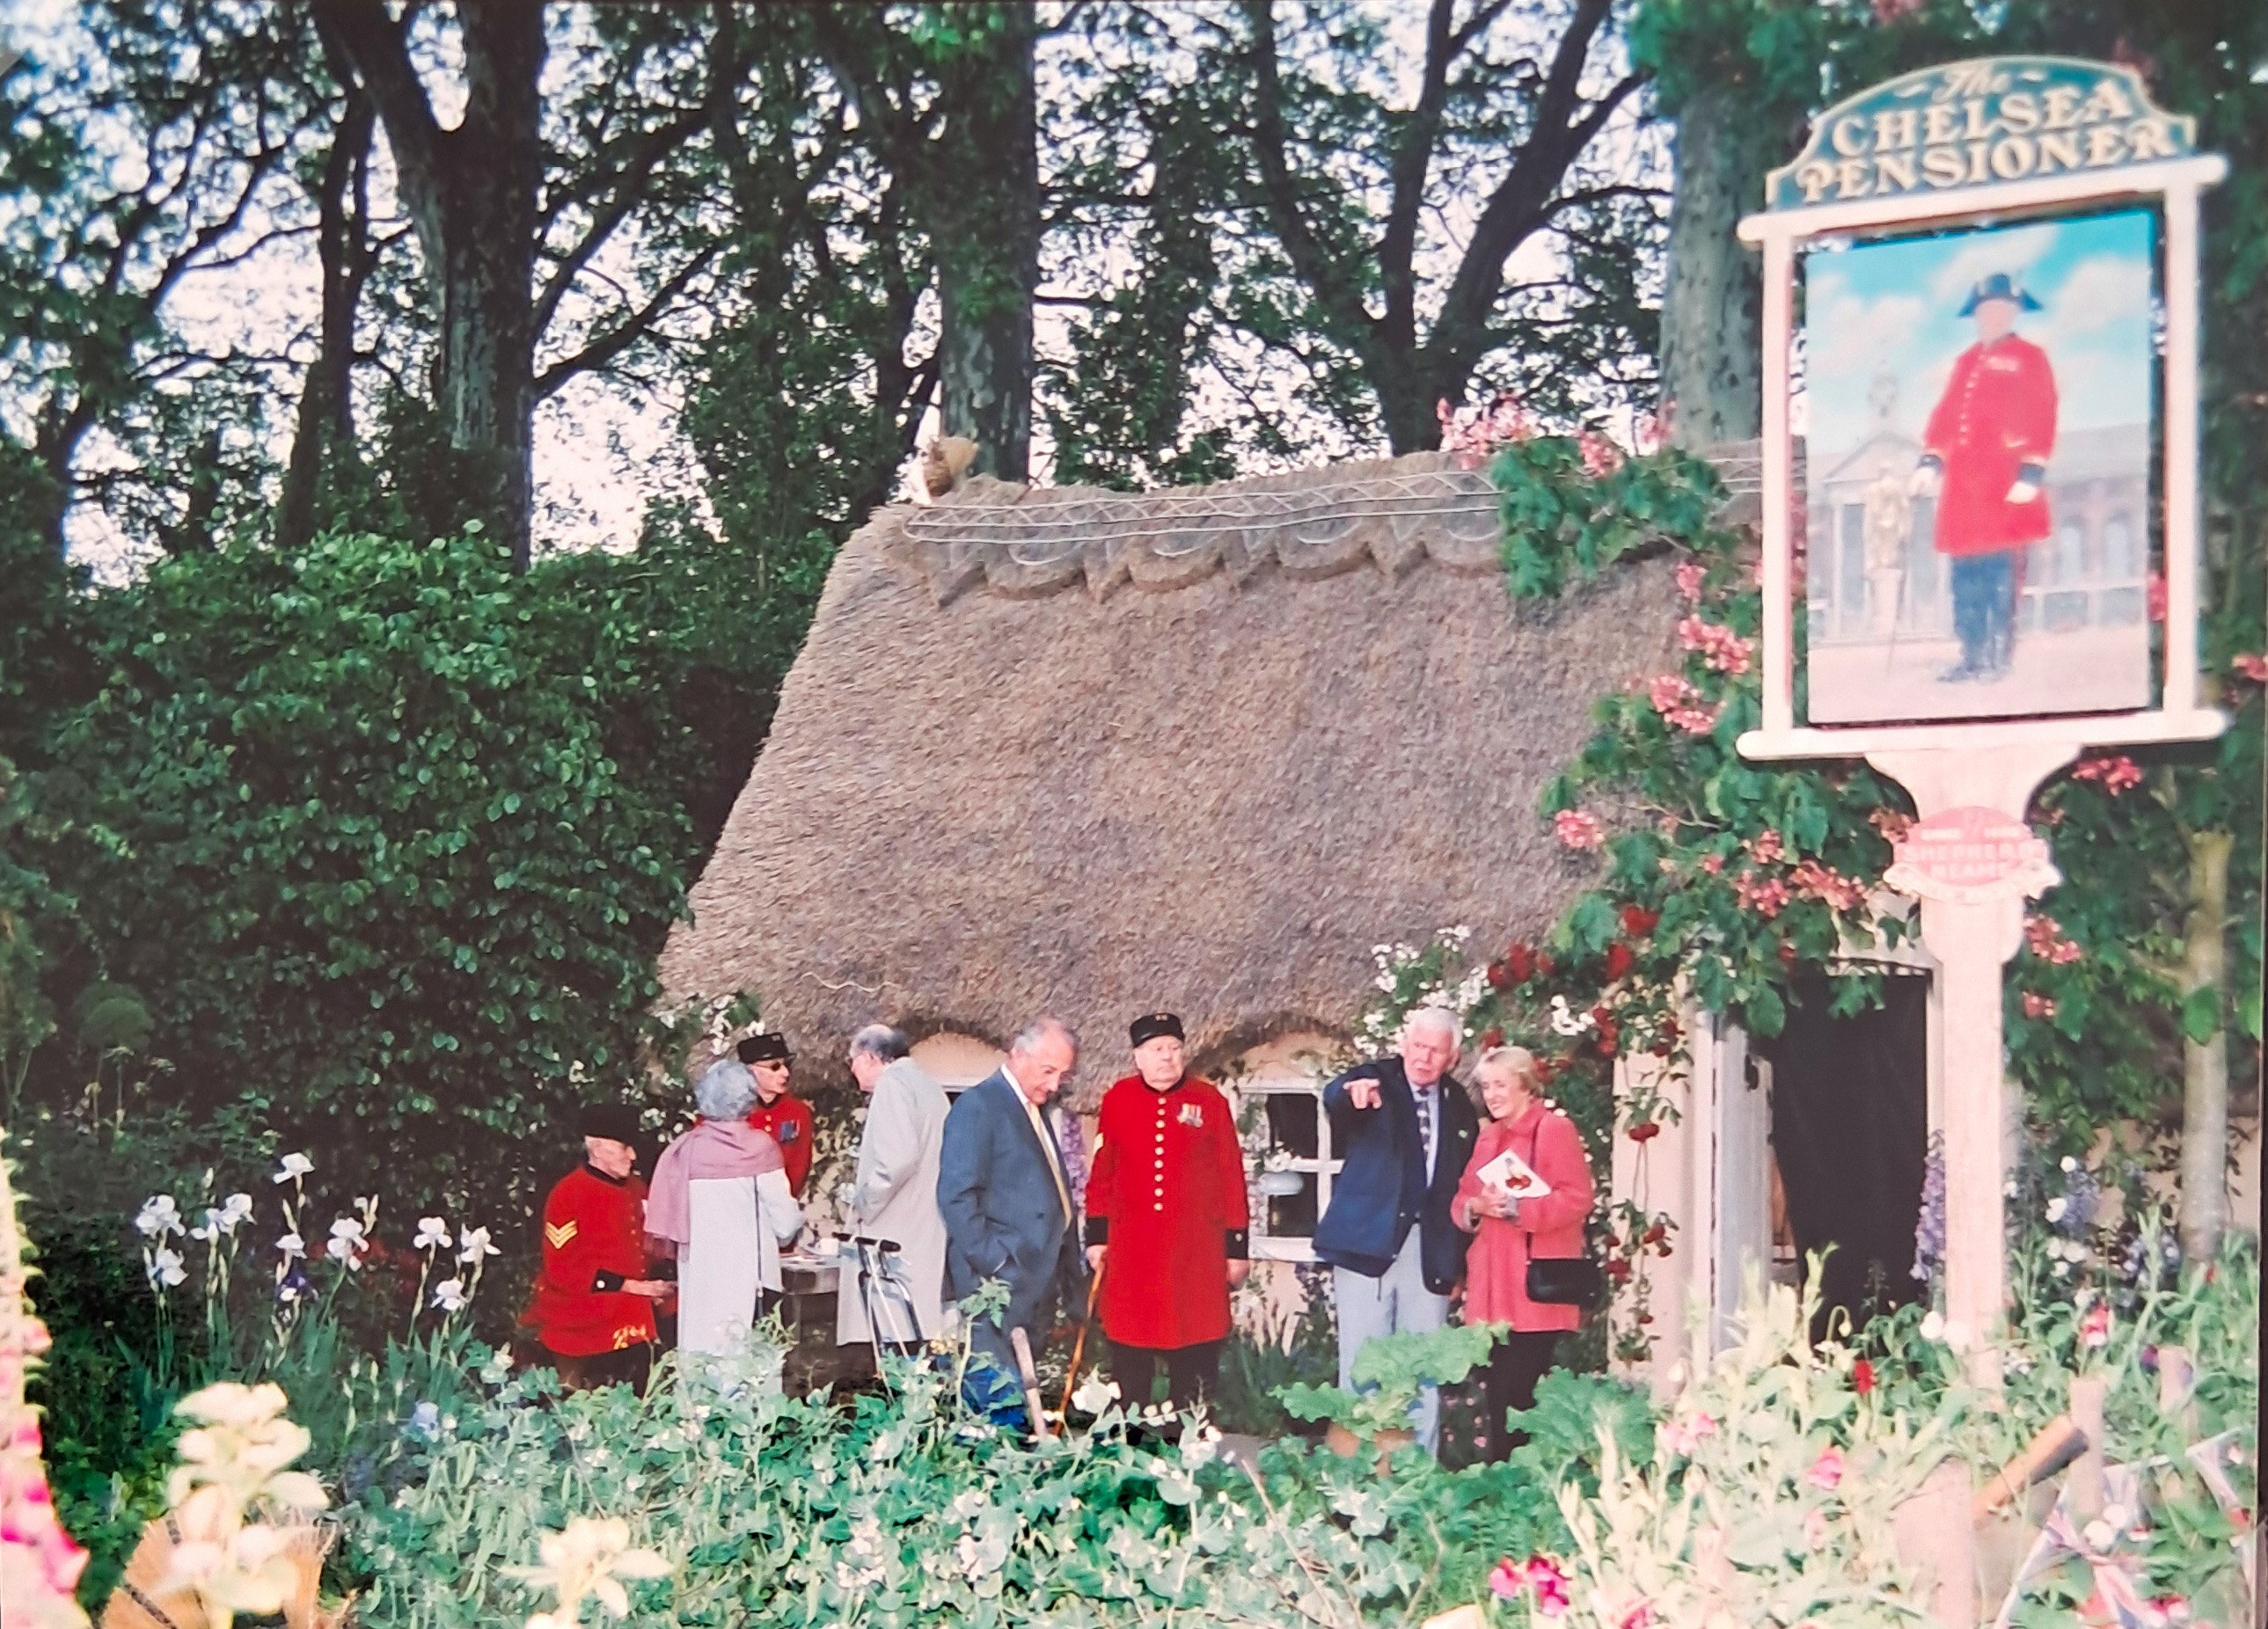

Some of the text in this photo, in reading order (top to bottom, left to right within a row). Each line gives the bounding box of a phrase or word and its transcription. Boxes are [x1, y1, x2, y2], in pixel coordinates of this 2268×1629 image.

[1833, 79, 2133, 157] CHELSEA
[1932, 63, 2011, 103] The
[1796, 117, 2178, 203] PENSIONER
